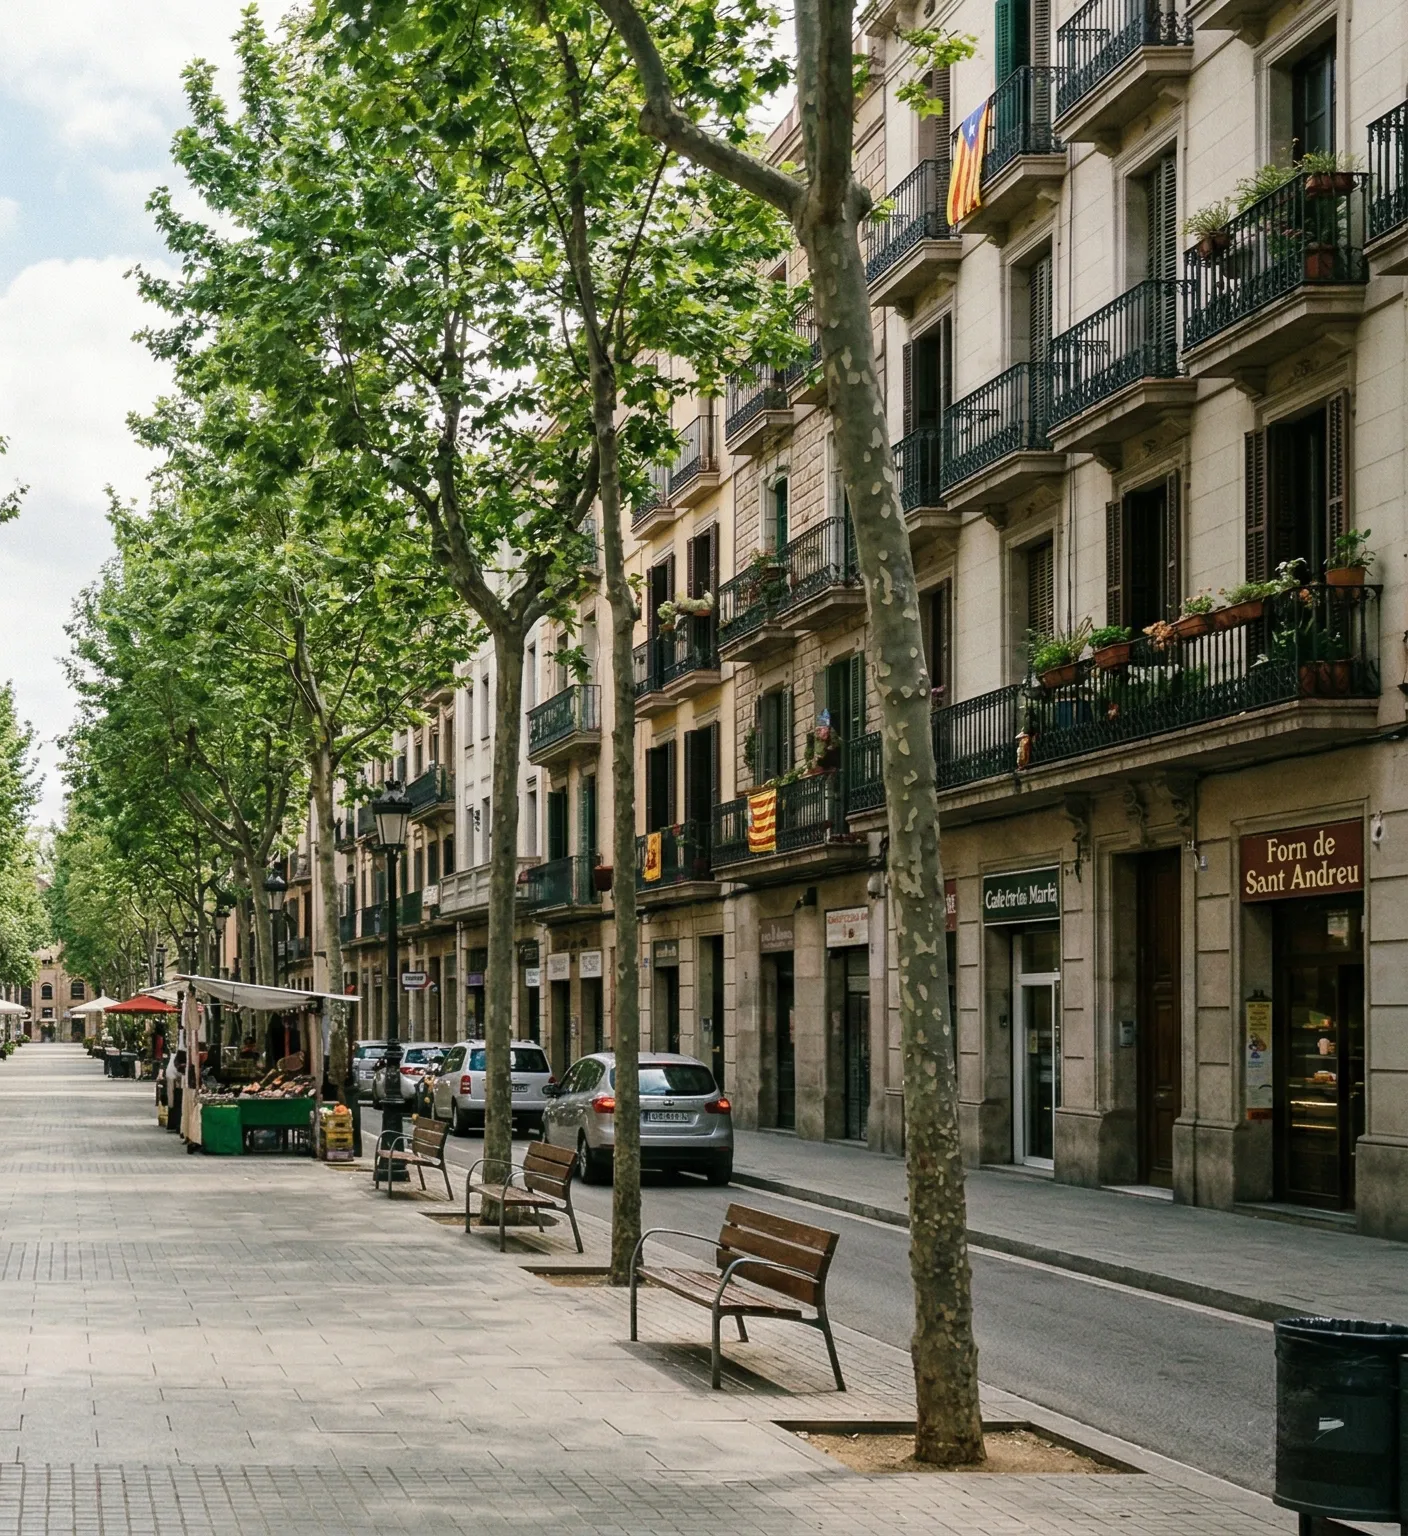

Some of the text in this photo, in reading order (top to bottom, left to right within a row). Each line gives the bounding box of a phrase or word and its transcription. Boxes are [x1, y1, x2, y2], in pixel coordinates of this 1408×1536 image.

[1266, 830, 1336, 863] Forn de
[1245, 860, 1359, 895] Sant Andreu
